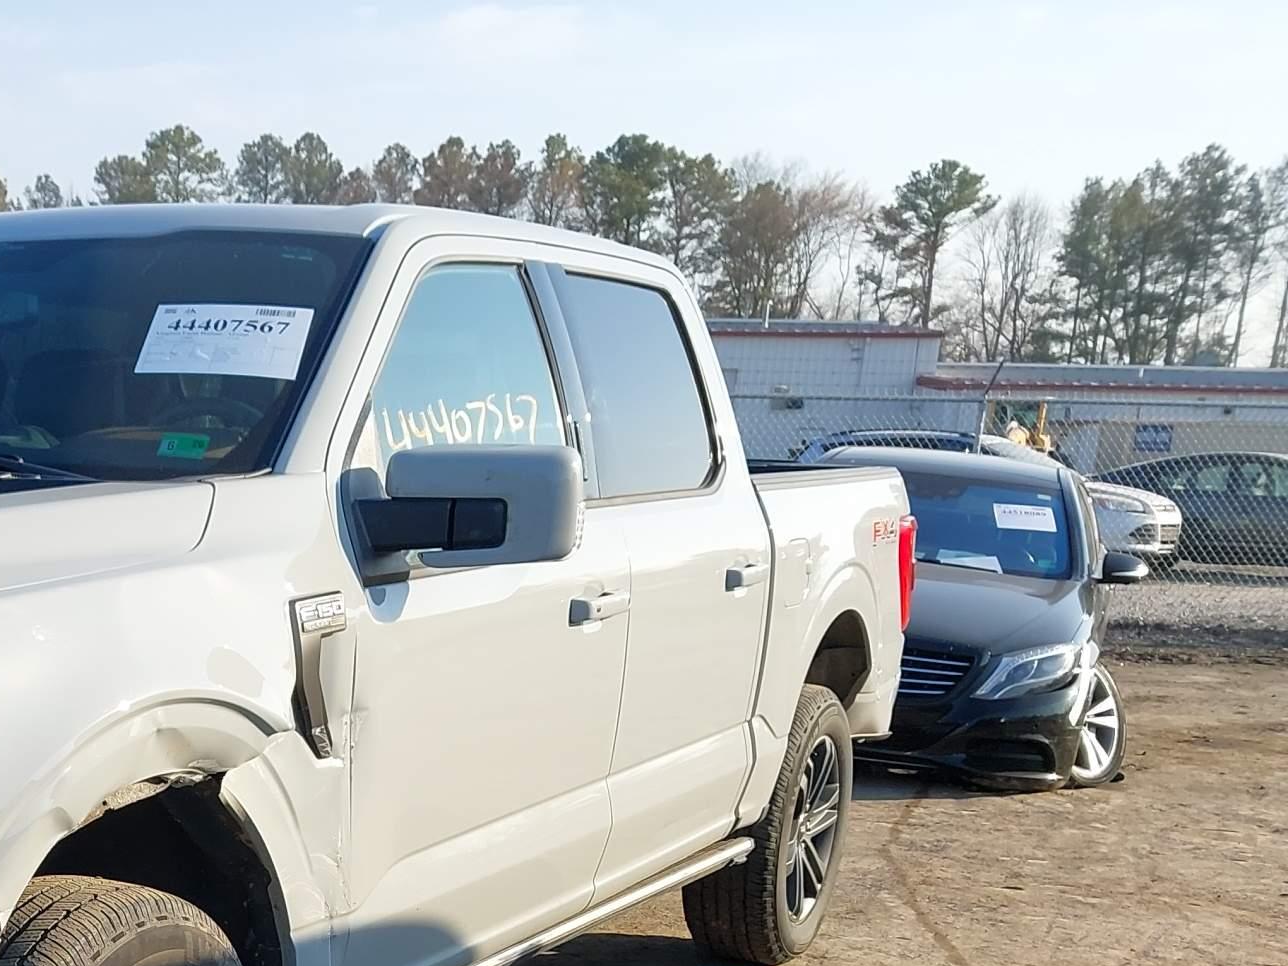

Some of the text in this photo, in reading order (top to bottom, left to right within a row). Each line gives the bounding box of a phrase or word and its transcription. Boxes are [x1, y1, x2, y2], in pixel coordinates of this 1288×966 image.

[167, 317, 290, 336] 44407567
[382, 393, 538, 450] 44407567
[872, 520, 898, 547] FX4
